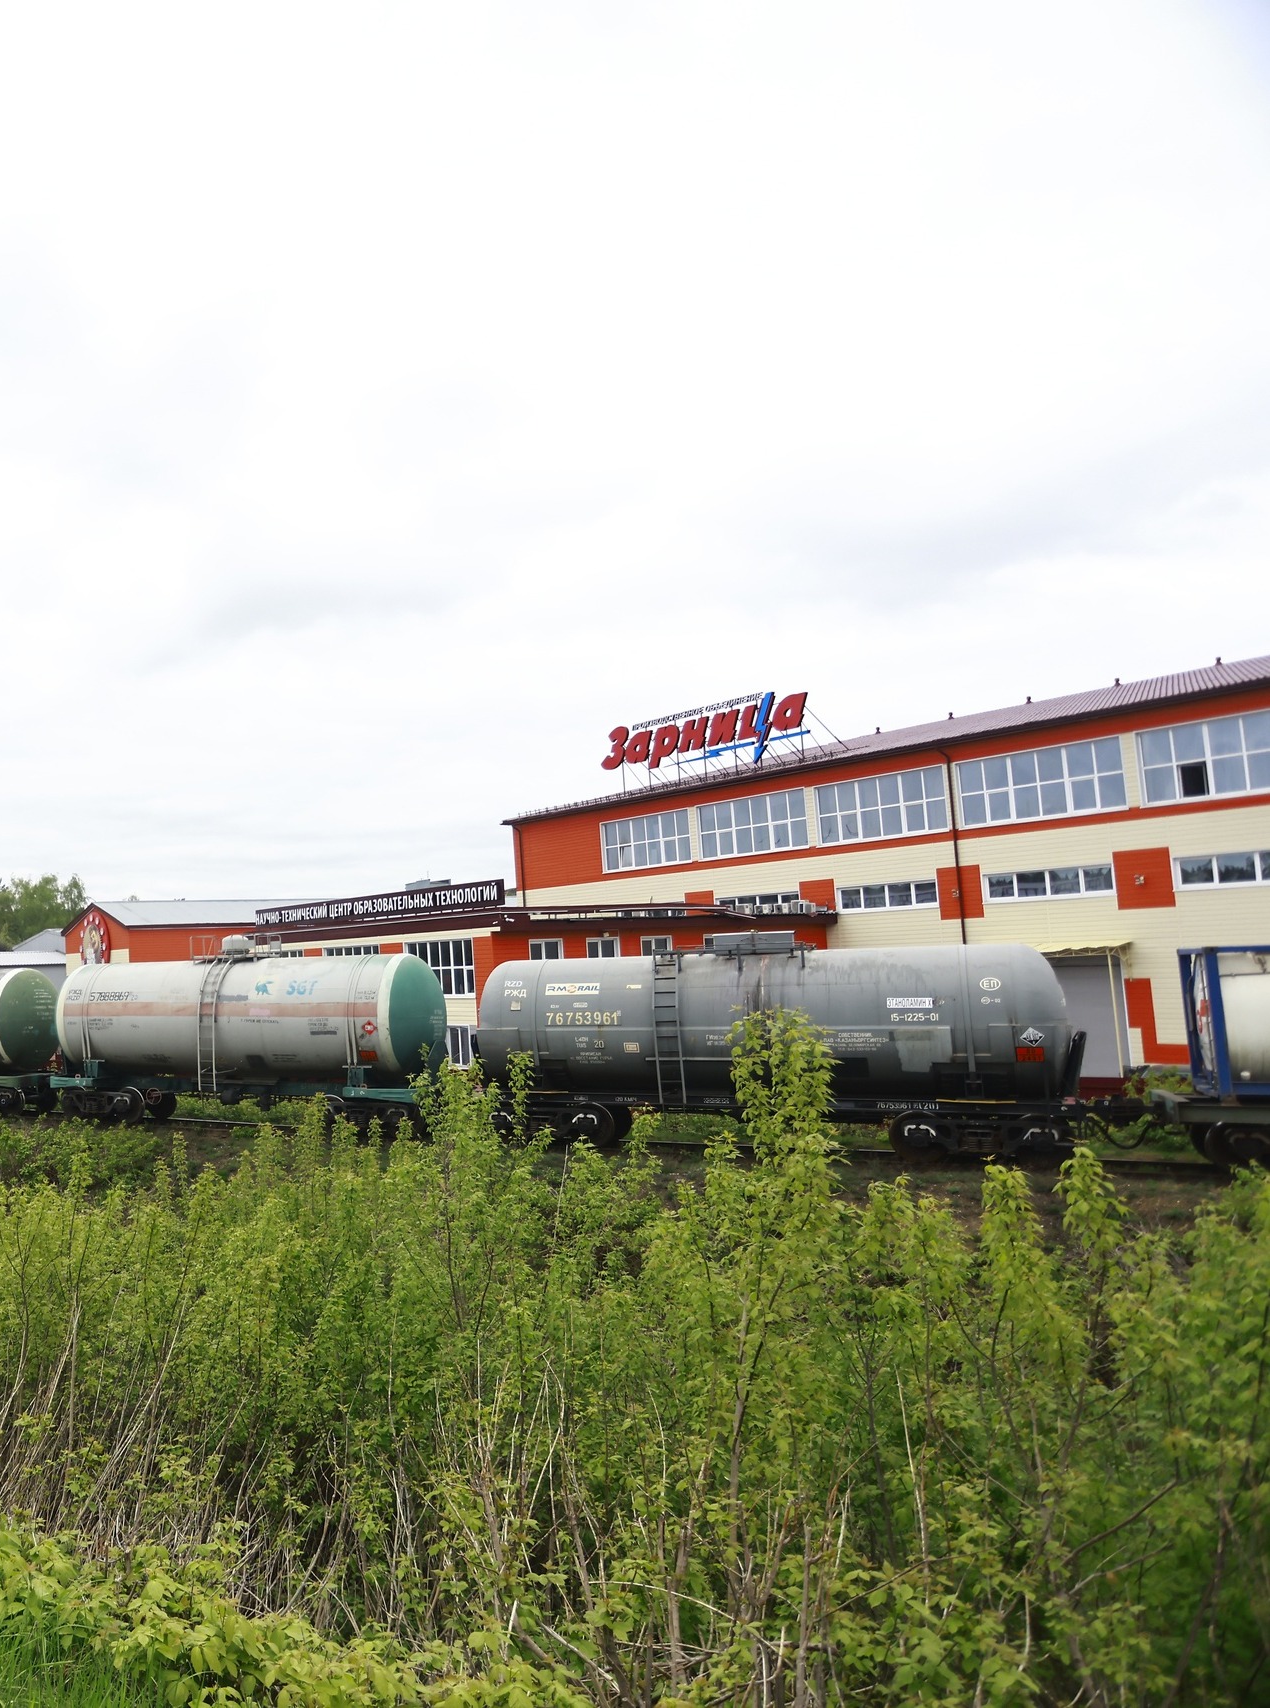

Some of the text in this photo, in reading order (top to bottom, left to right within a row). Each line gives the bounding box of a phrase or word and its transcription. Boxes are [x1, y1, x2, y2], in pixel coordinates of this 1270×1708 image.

[632, 691, 764, 731] ПРОИЗВОДСТВЕННОЕ ОБЪЕДИНЕНИЕ
[601, 692, 808, 770] Зарница
[255, 883, 498, 926] НАУЧНО-ТЕХНИЧЕСКИЙ ЦЕНТР ОБРАЗОВАТЕЛЬНЫХ ТЕХНОЛОГИЙ
[286, 980, 318, 996] SGT
[504, 980, 523, 988] RZD
[577, 984, 600, 992] RAIL
[90, 991, 130, 1002] 57888869
[504, 989, 527, 998] РЖД
[546, 1011, 619, 1026] 76753961
[890, 1012, 939, 1022] 15-1225-01
[593, 1040, 605, 1049] 20
